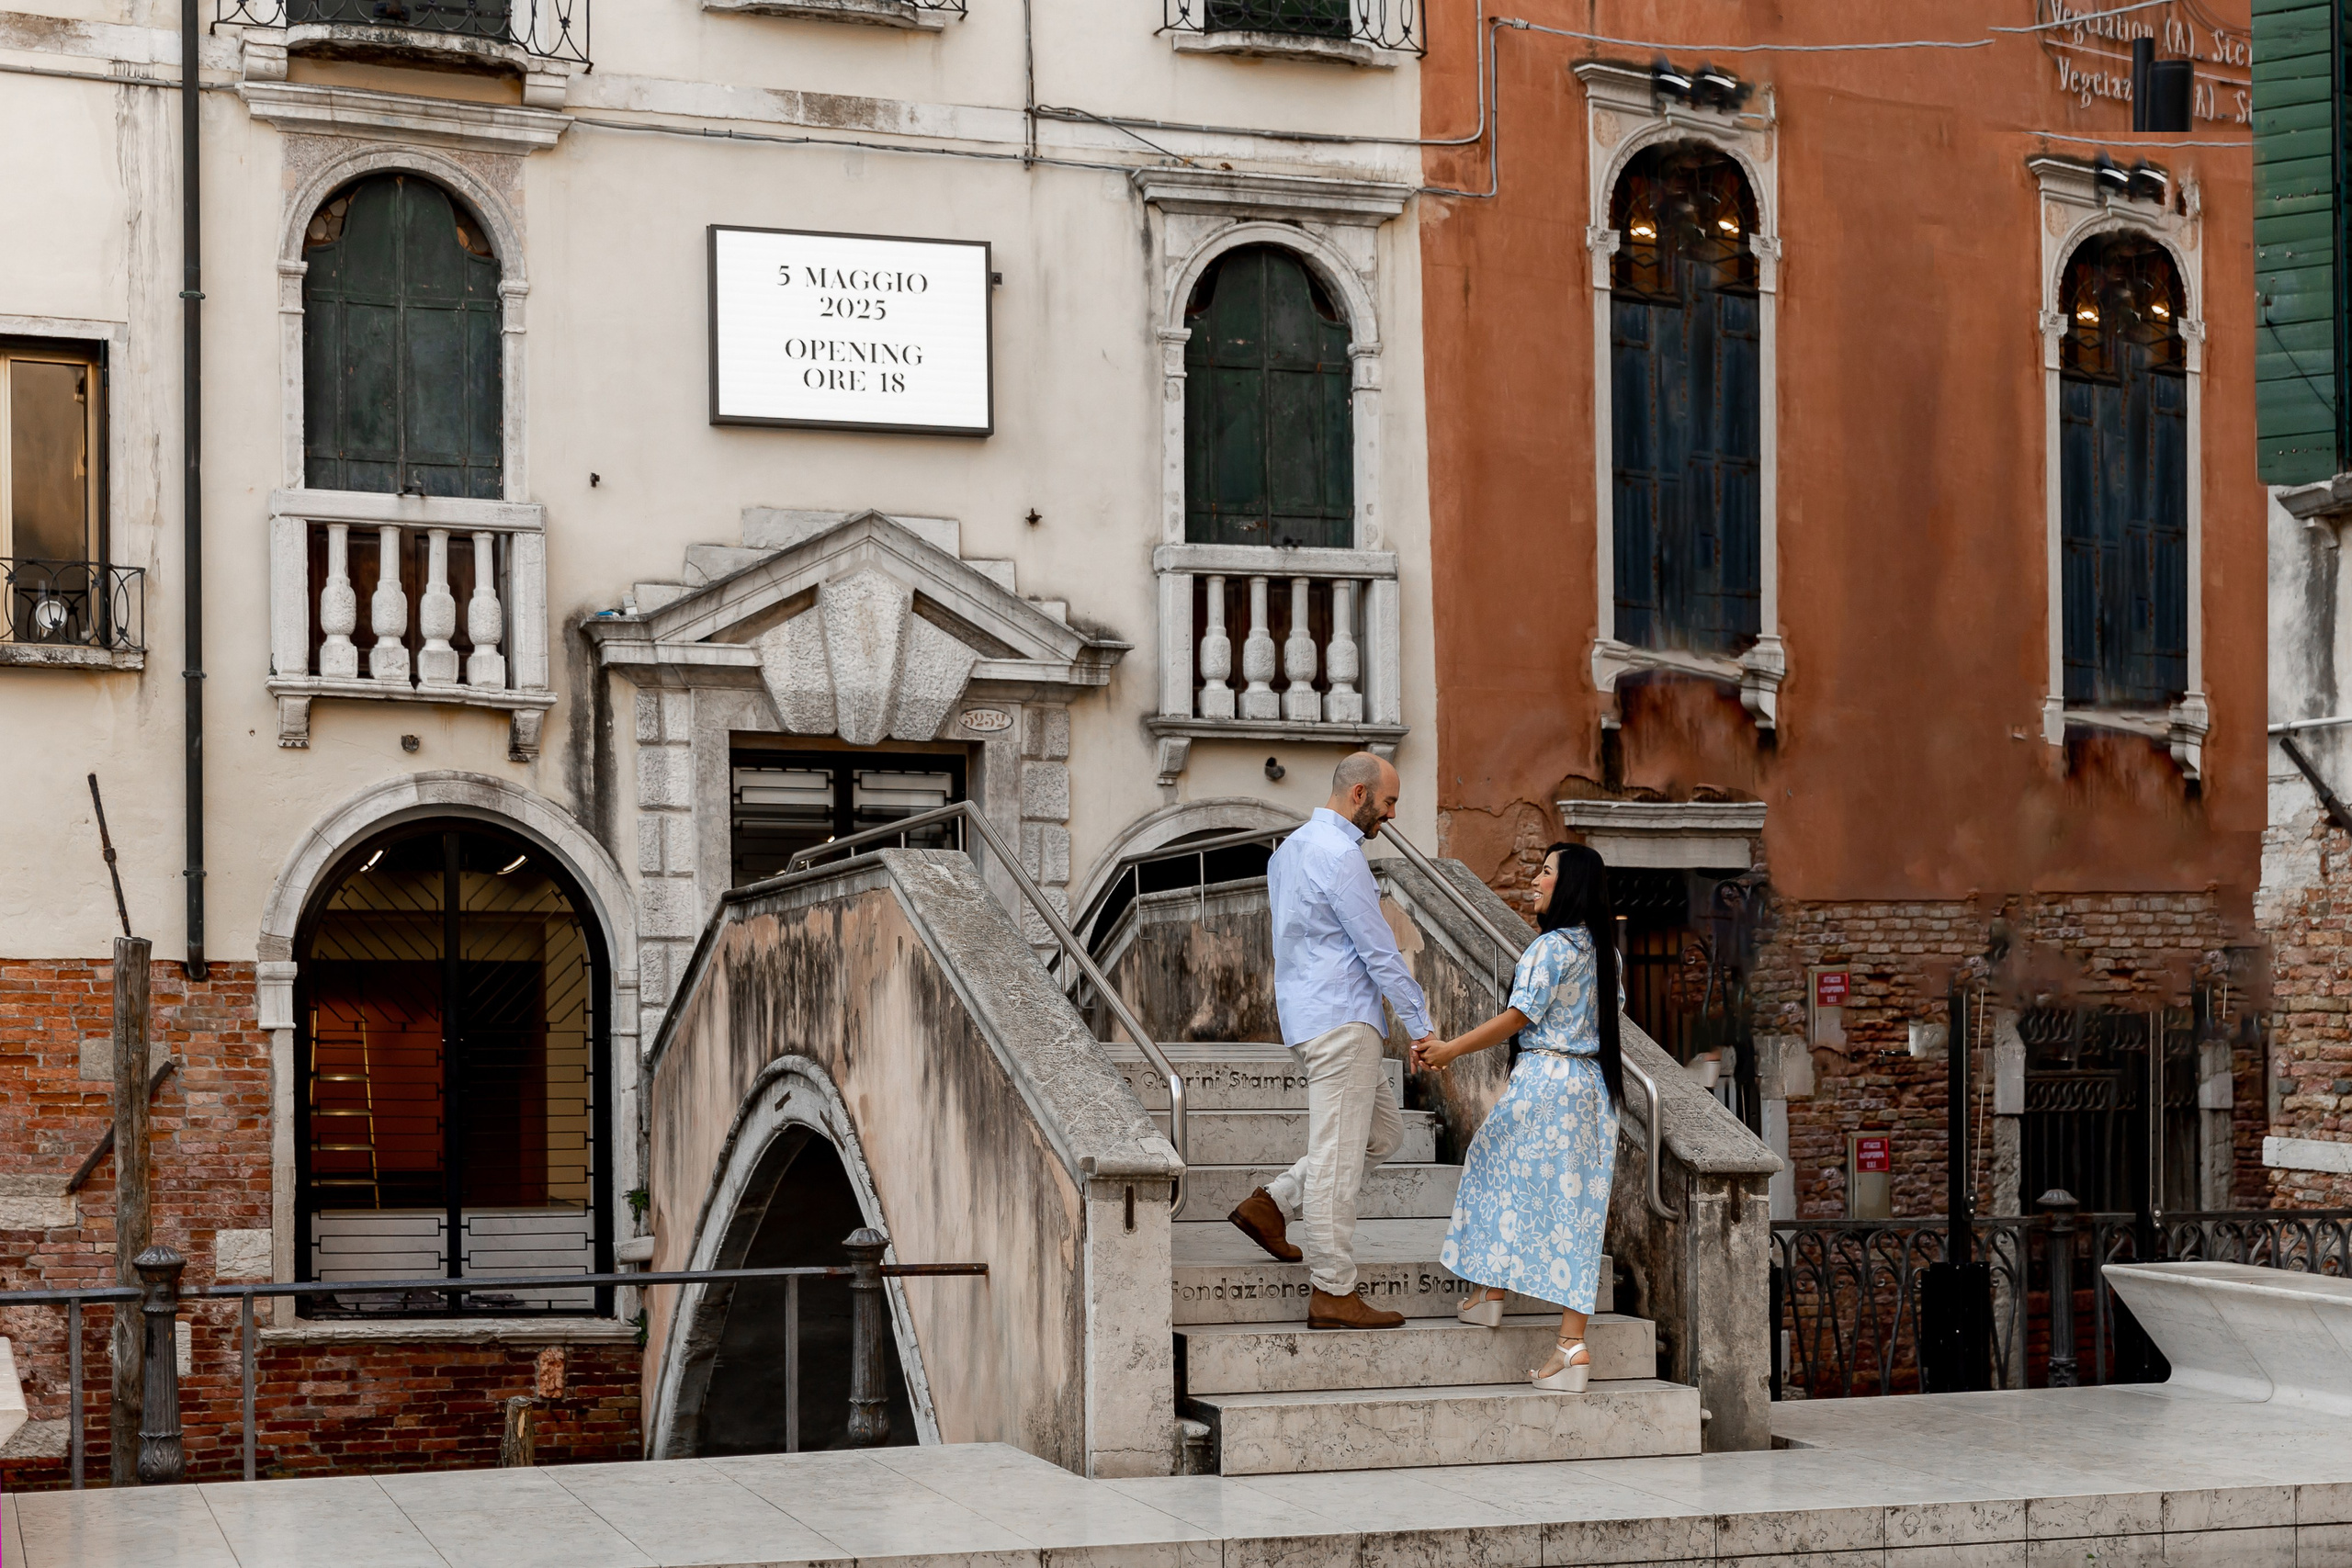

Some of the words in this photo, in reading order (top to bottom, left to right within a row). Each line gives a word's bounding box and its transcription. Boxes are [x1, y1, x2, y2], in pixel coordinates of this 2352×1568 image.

[776, 265, 791, 287] 5
[805, 265, 929, 294] MAGGIO
[820, 297, 888, 320] 2025
[785, 338, 923, 366] OPENING
[803, 367, 866, 391] ORE
[880, 372, 905, 393] 18
[1355, 1273, 1409, 1297] erini
